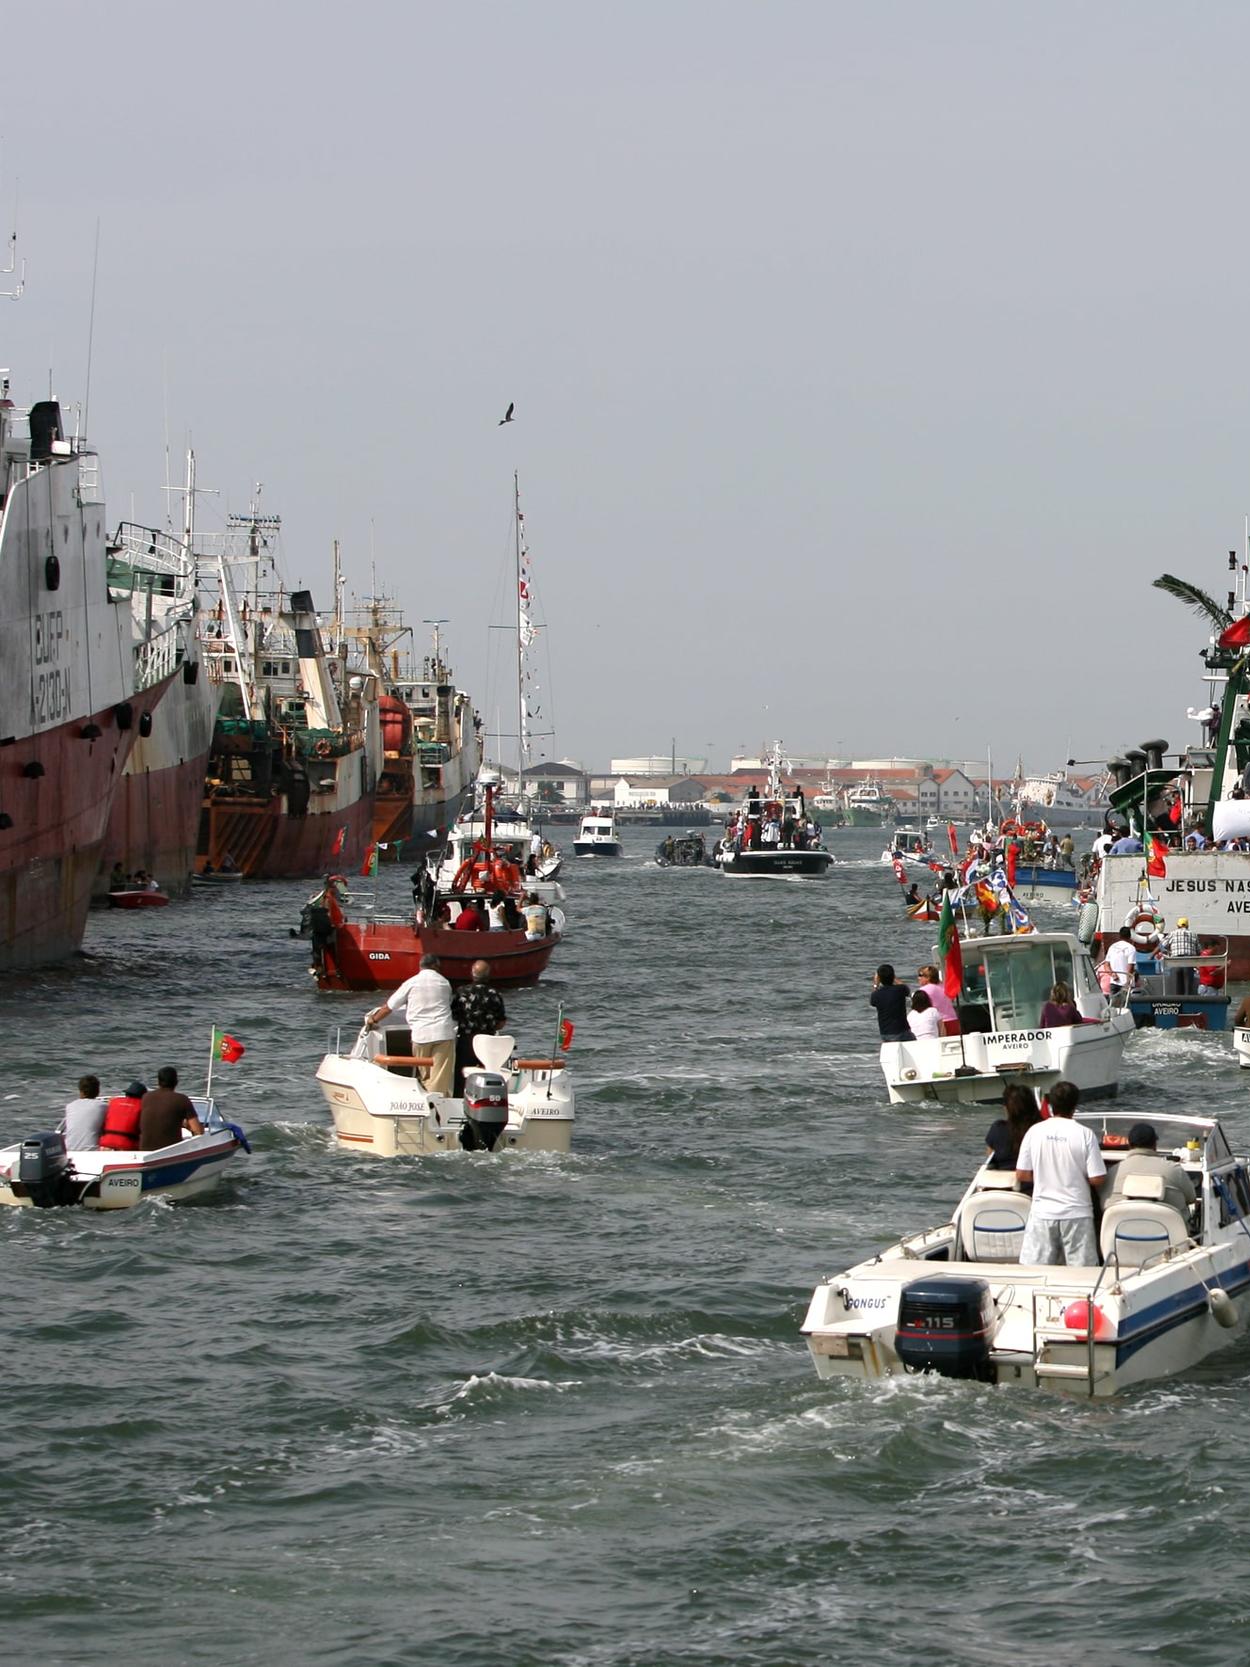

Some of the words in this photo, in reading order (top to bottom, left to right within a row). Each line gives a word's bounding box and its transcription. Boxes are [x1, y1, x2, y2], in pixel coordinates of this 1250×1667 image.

[1166, 880, 1217, 892] JESUS
[983, 1031, 1053, 1046] IMPERADOR
[532, 1108, 559, 1116] AVEIRO
[24, 1152, 39, 1160] 25
[109, 1179, 139, 1187] AVEIRO
[926, 1317, 954, 1328] 115
